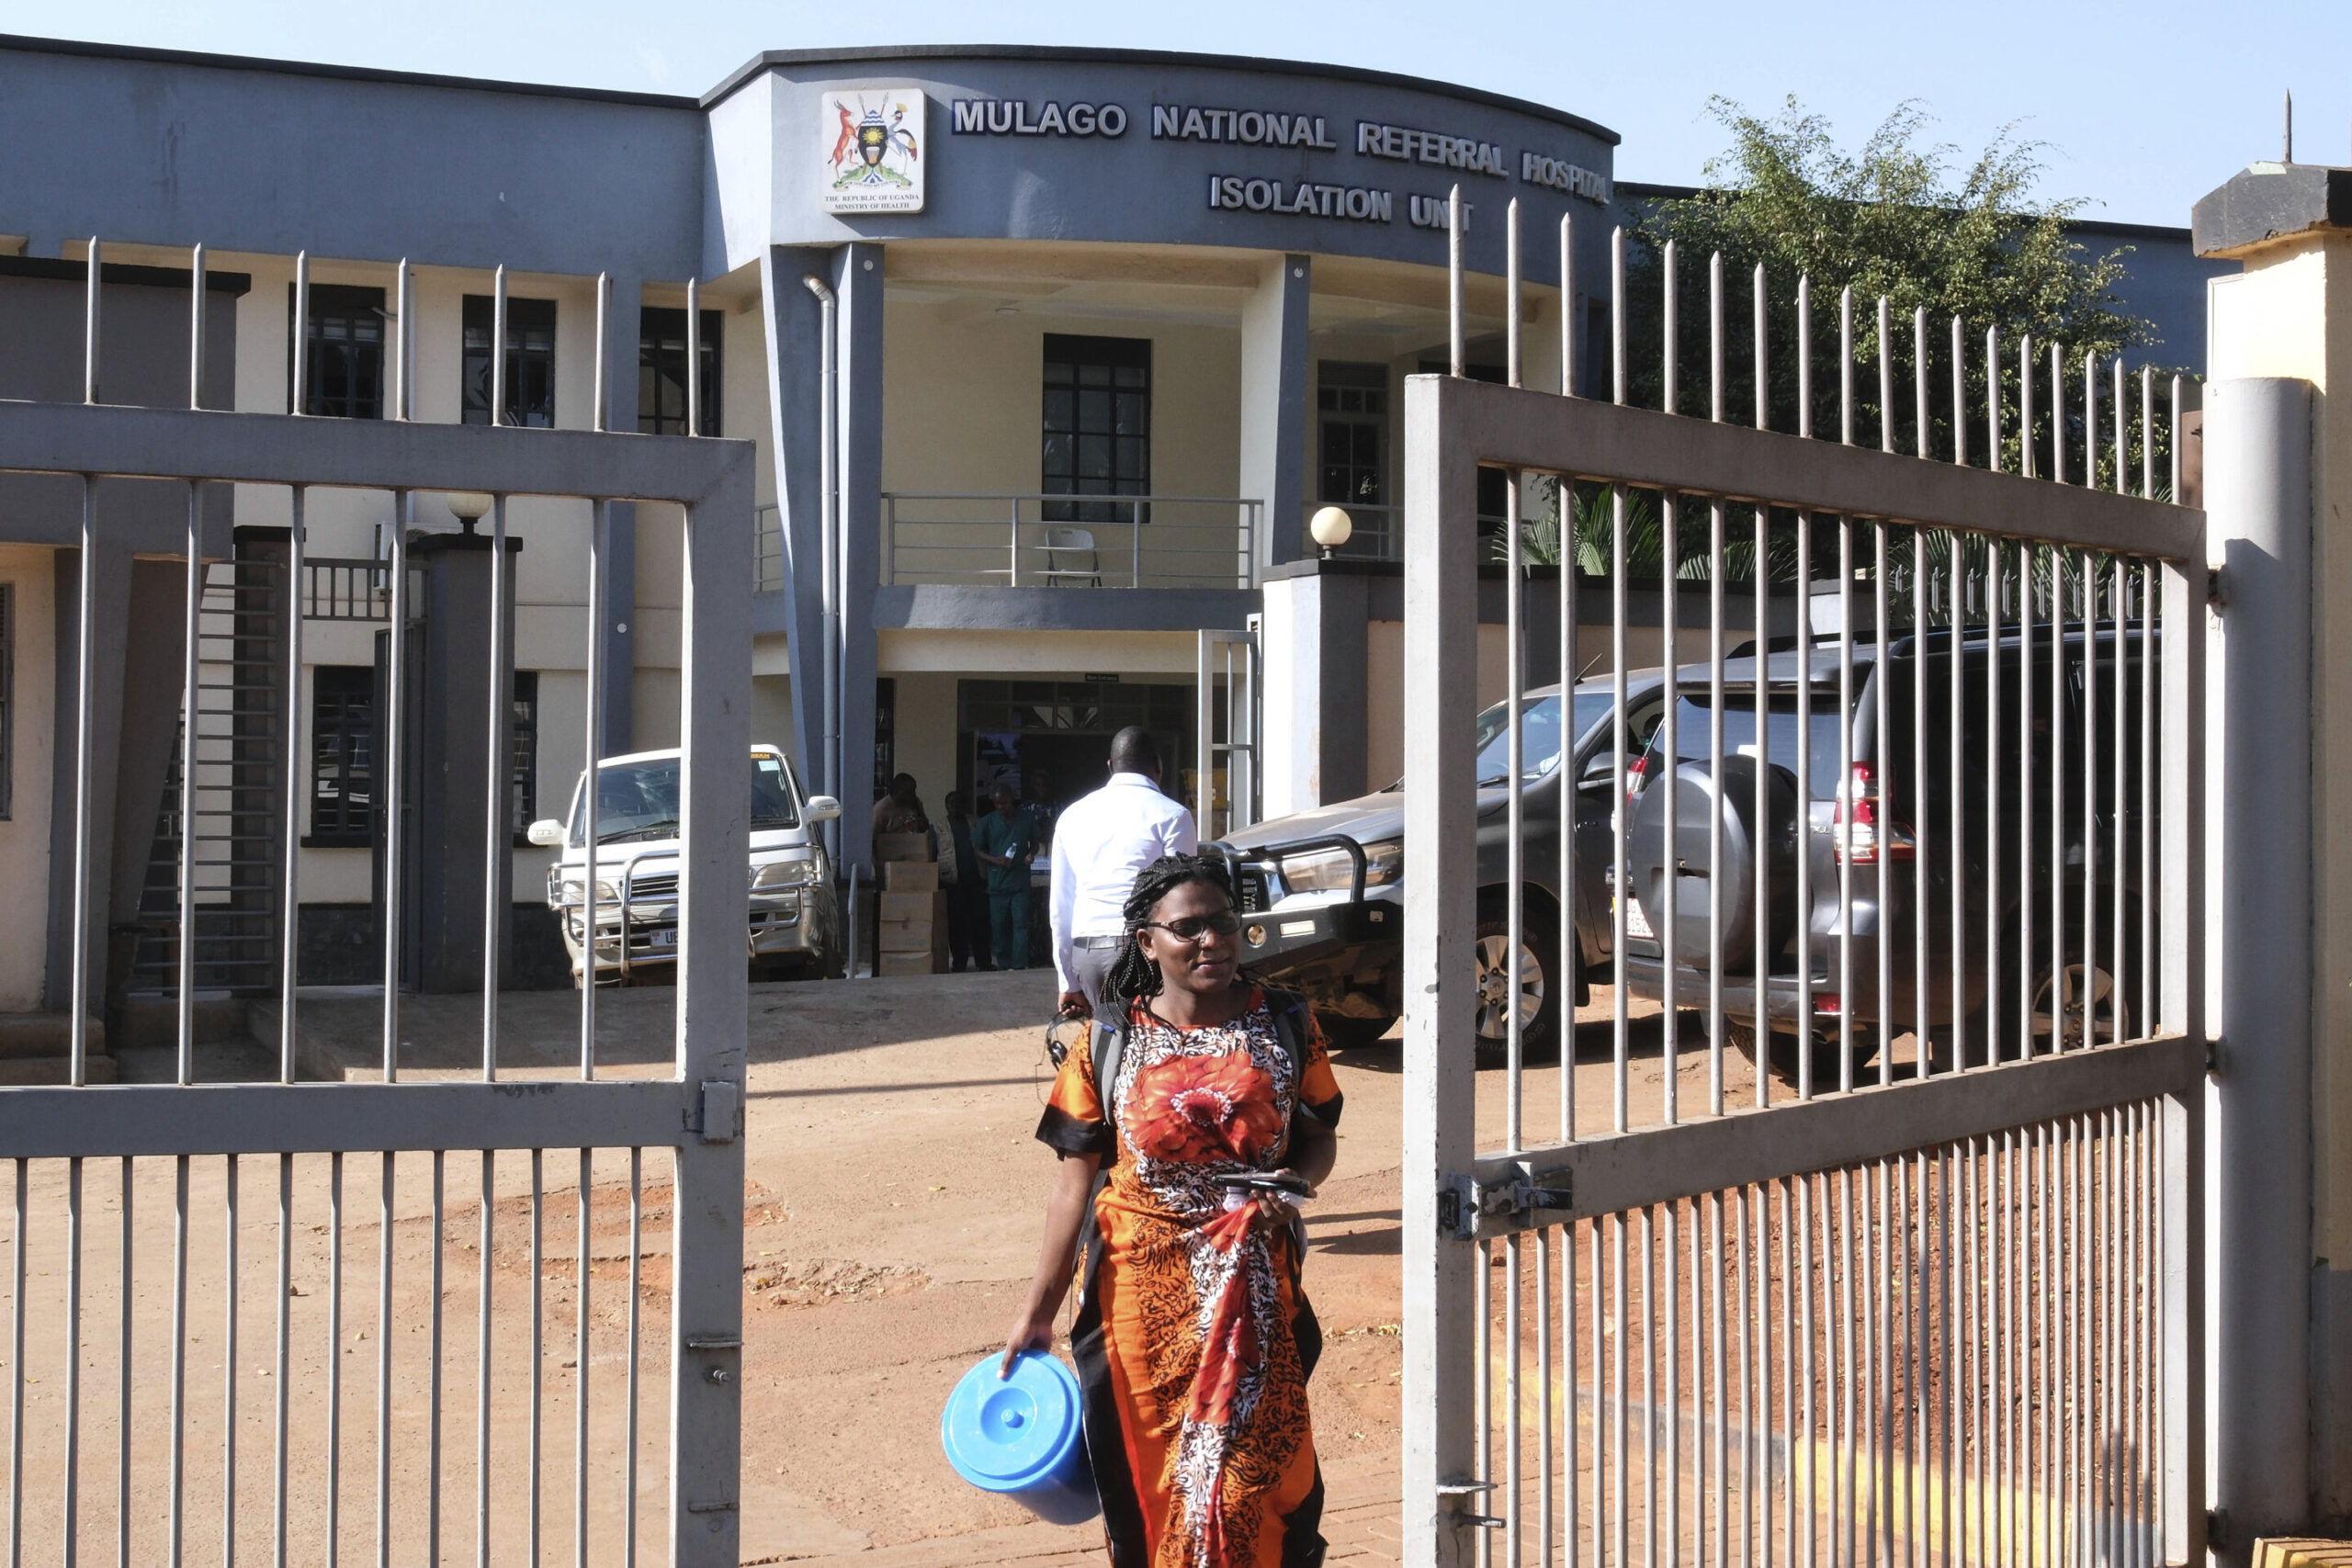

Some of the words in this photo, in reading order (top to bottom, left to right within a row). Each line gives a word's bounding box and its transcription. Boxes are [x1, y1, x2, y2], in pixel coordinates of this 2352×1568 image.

[953, 98, 1129, 138] MULAGO
[1152, 104, 1337, 151] NATIONAL
[1357, 120, 1510, 177] REFERRAL
[1521, 151, 1611, 206] HOSPITAL
[1210, 175, 1392, 223] ISOLATION
[1409, 194, 1475, 231] UNT
